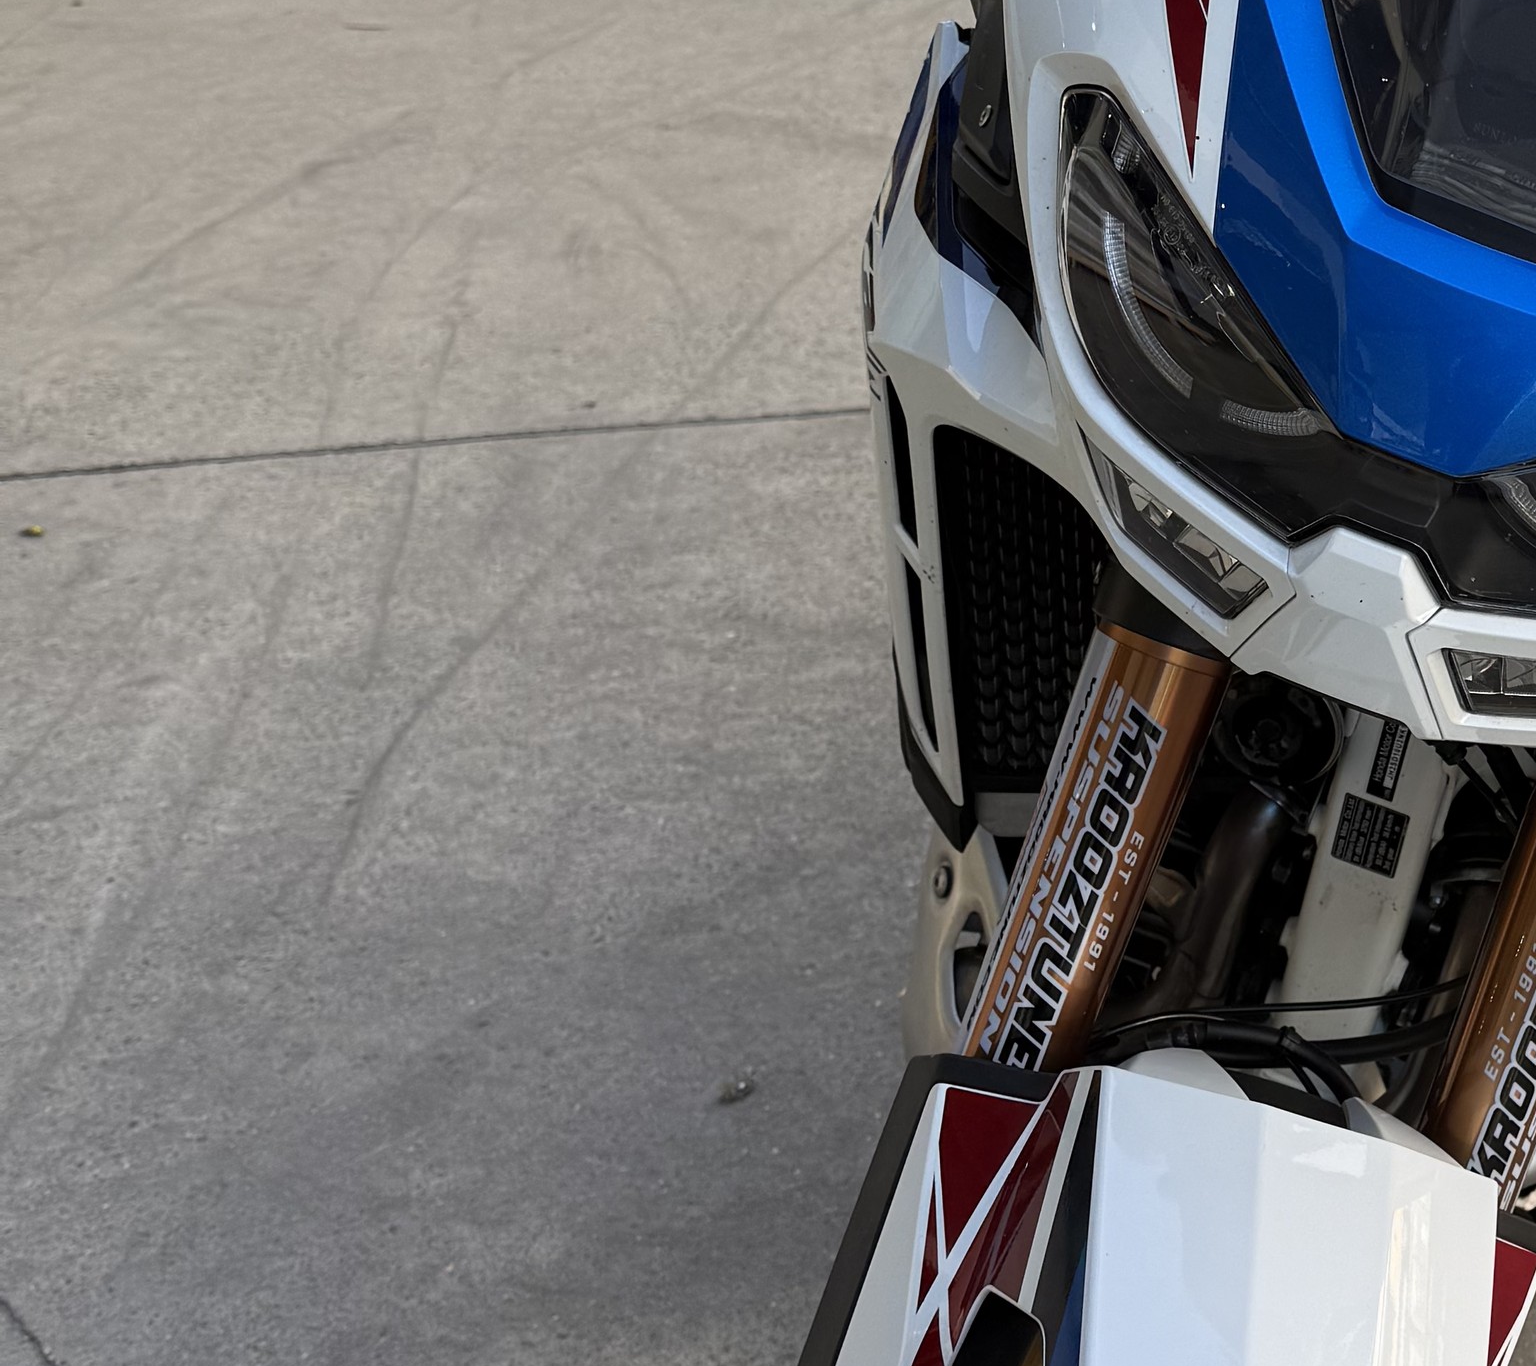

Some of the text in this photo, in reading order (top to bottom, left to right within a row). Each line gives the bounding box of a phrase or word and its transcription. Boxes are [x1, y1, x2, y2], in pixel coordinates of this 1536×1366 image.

[979, 680, 1126, 1055] SUSPENSION
[992, 697, 1167, 1072] KROOZTUNE
[1119, 830, 1145, 885] EST
[1083, 911, 1115, 973] 1991
[1484, 1029, 1511, 1082] EST
